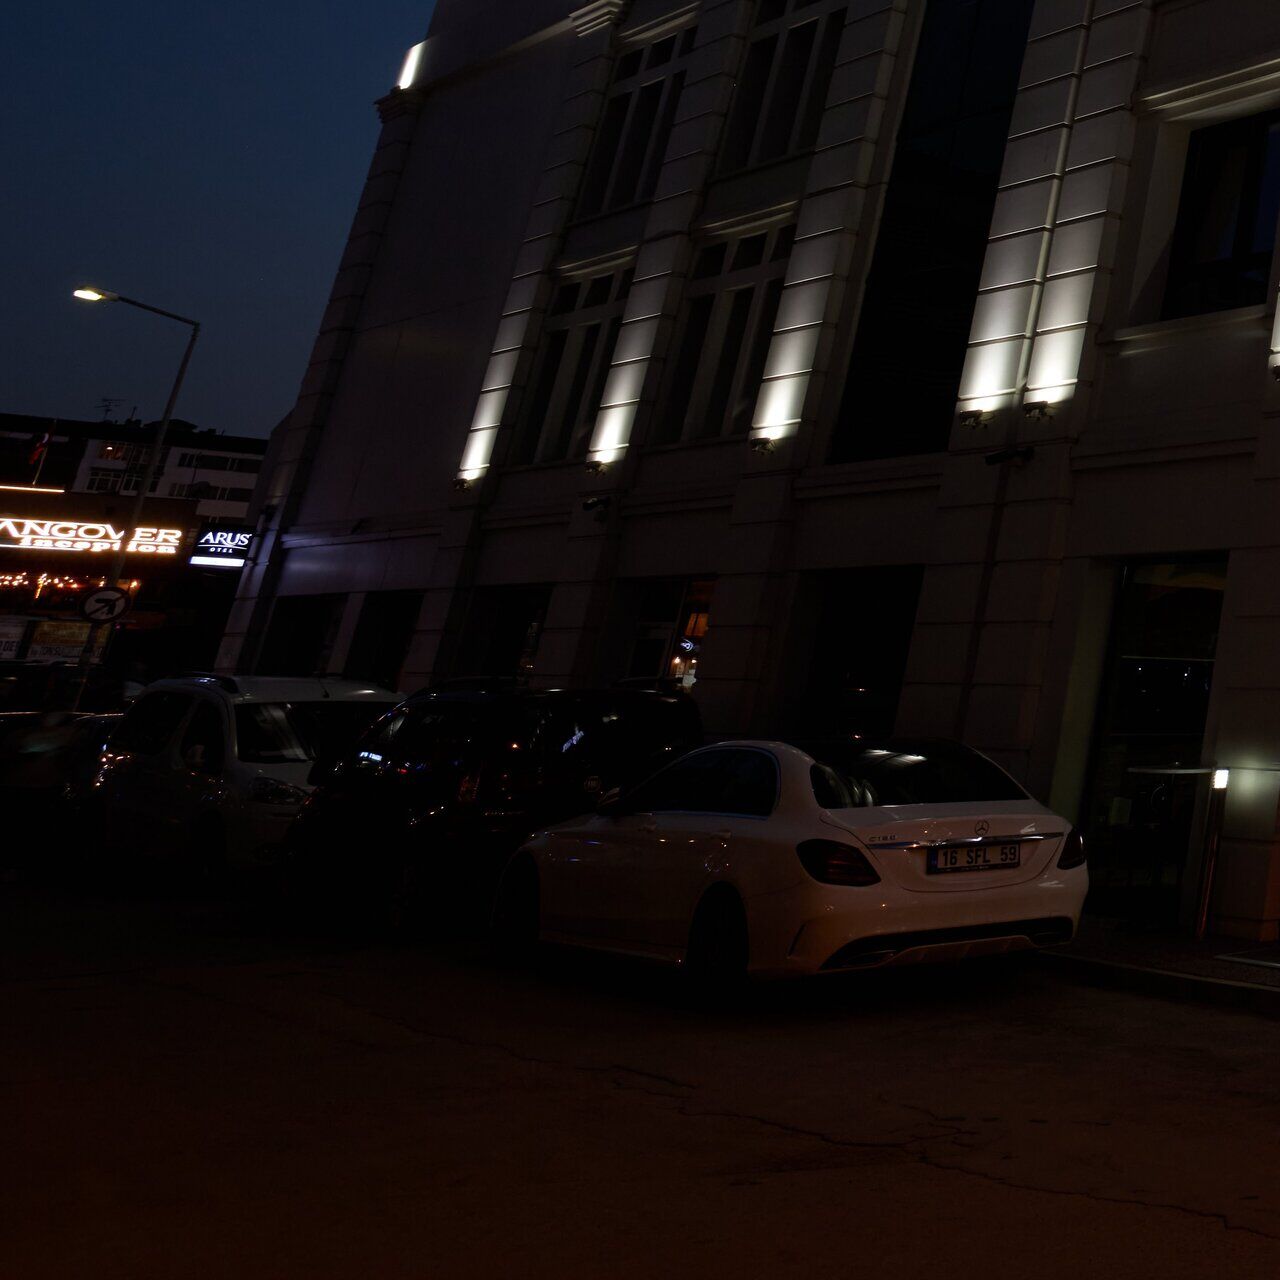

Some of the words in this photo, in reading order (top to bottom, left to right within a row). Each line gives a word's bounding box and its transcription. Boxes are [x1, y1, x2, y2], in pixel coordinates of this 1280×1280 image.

[200, 531, 252, 547] ARUS
[942, 849, 958, 867] 16
[966, 846, 991, 865] SFL
[1000, 843, 1017, 862] 59
